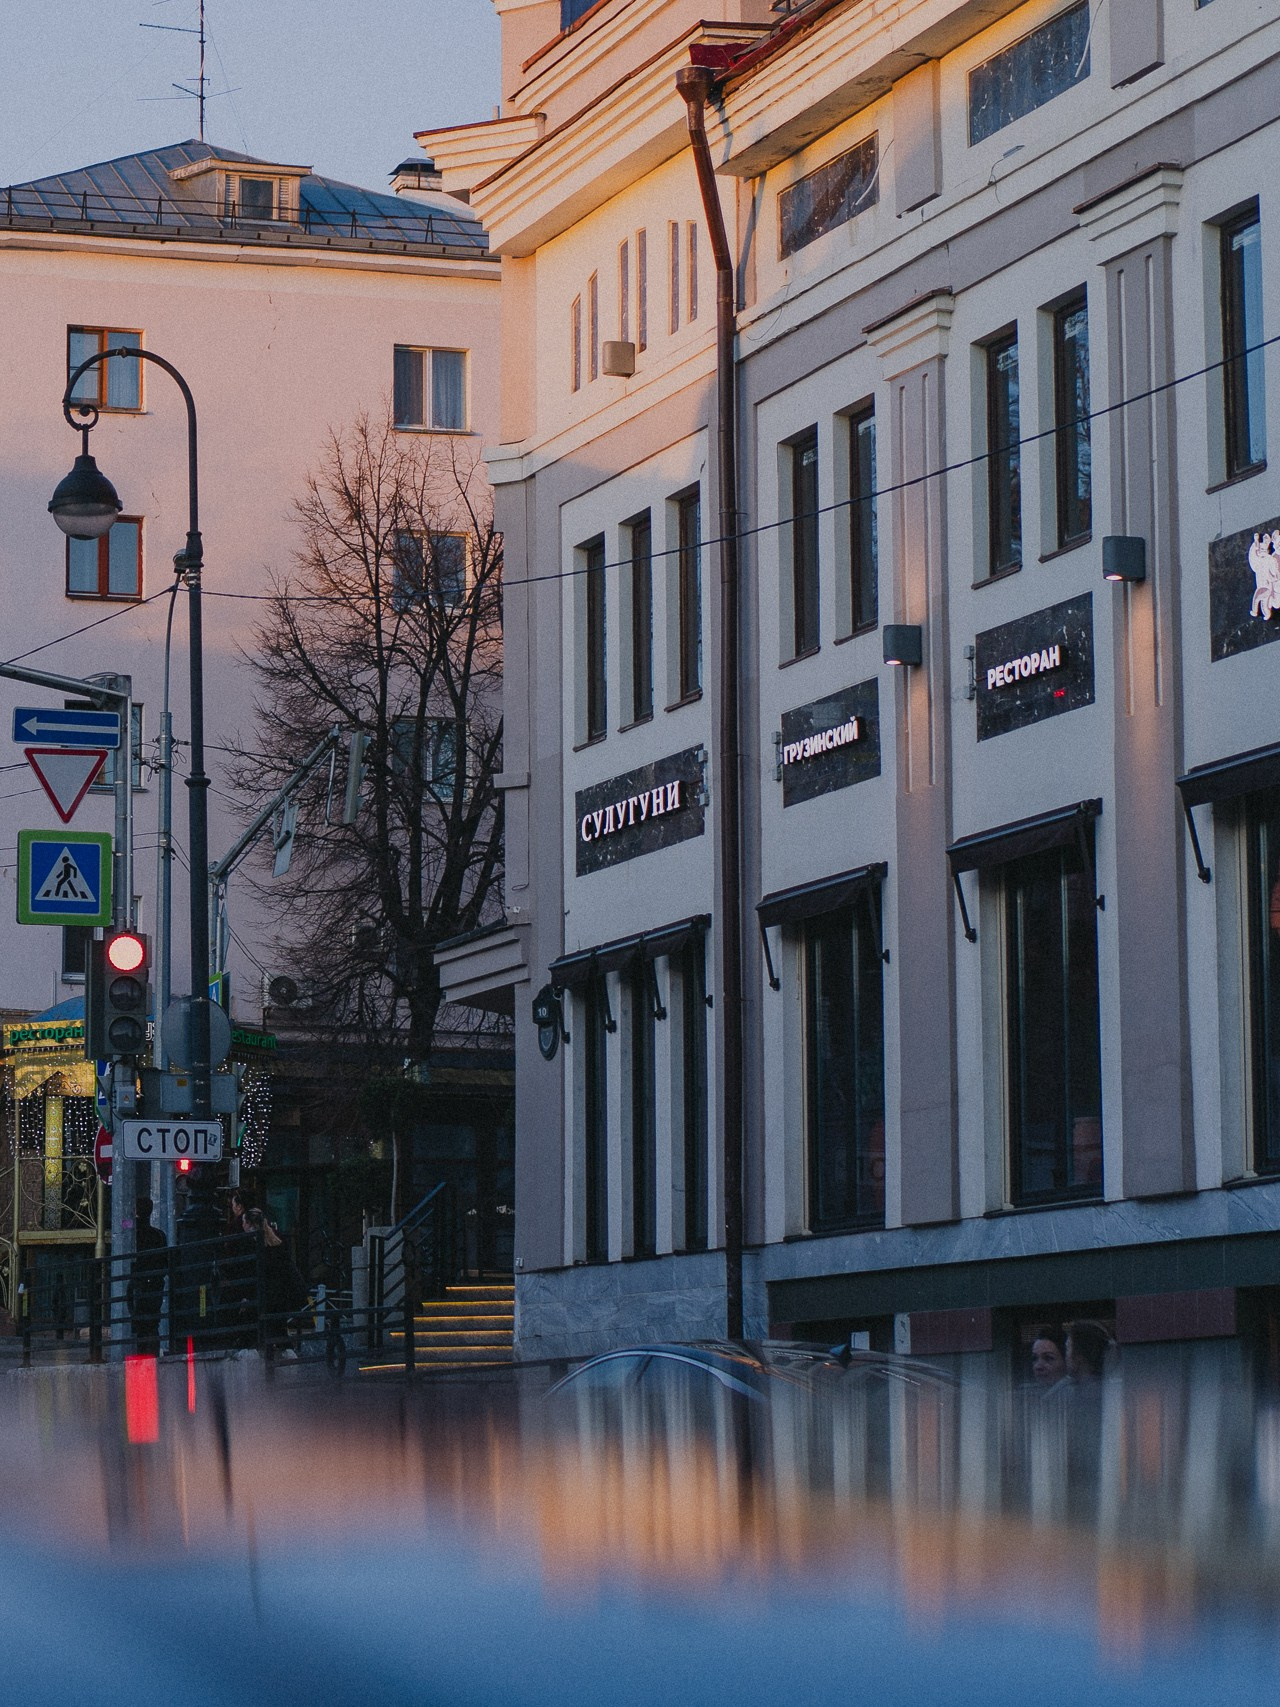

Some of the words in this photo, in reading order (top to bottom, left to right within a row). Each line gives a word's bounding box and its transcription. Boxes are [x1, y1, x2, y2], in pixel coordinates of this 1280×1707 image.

[987, 644, 1061, 690] РЕСТОРАН
[783, 715, 859, 765] ГРУЗИНСКИЙ
[581, 780, 680, 842] СУЛУГУНИ
[538, 1007, 547, 1017] 10
[9, 1026, 85, 1046] ресторан
[231, 1029, 277, 1049] estaurant
[137, 1127, 208, 1154] СТОП
